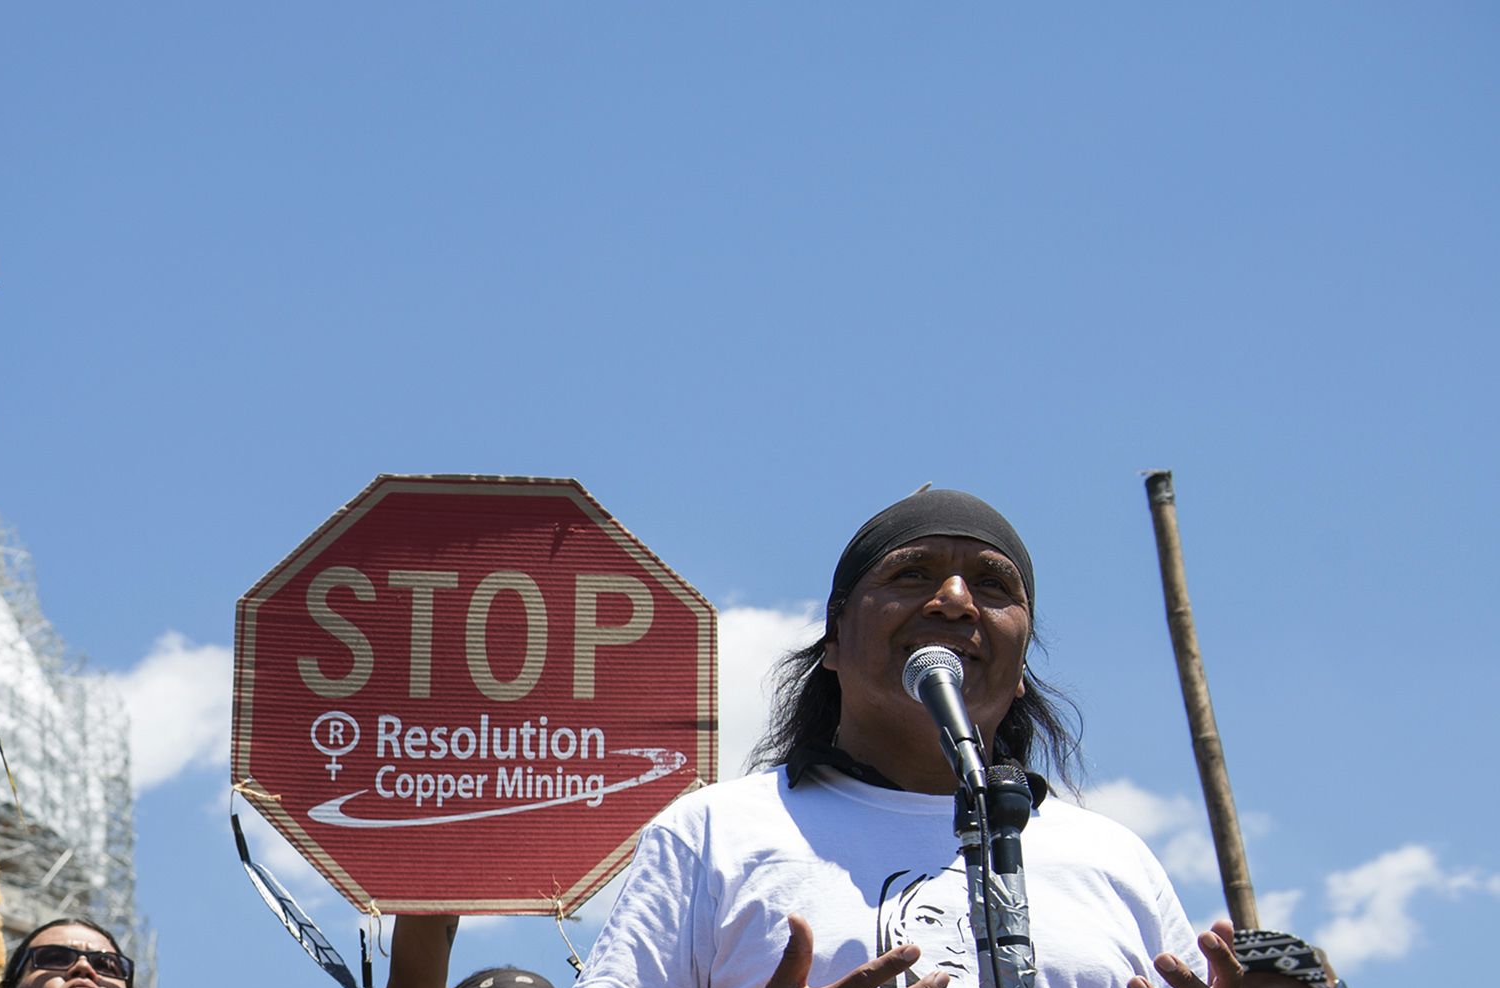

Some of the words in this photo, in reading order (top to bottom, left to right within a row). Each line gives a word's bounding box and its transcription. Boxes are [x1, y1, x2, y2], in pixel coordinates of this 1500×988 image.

[297, 566, 655, 701] STOP
[377, 714, 605, 760] Resolution
[375, 765, 488, 808] Copper
[496, 766, 605, 808] Mining
